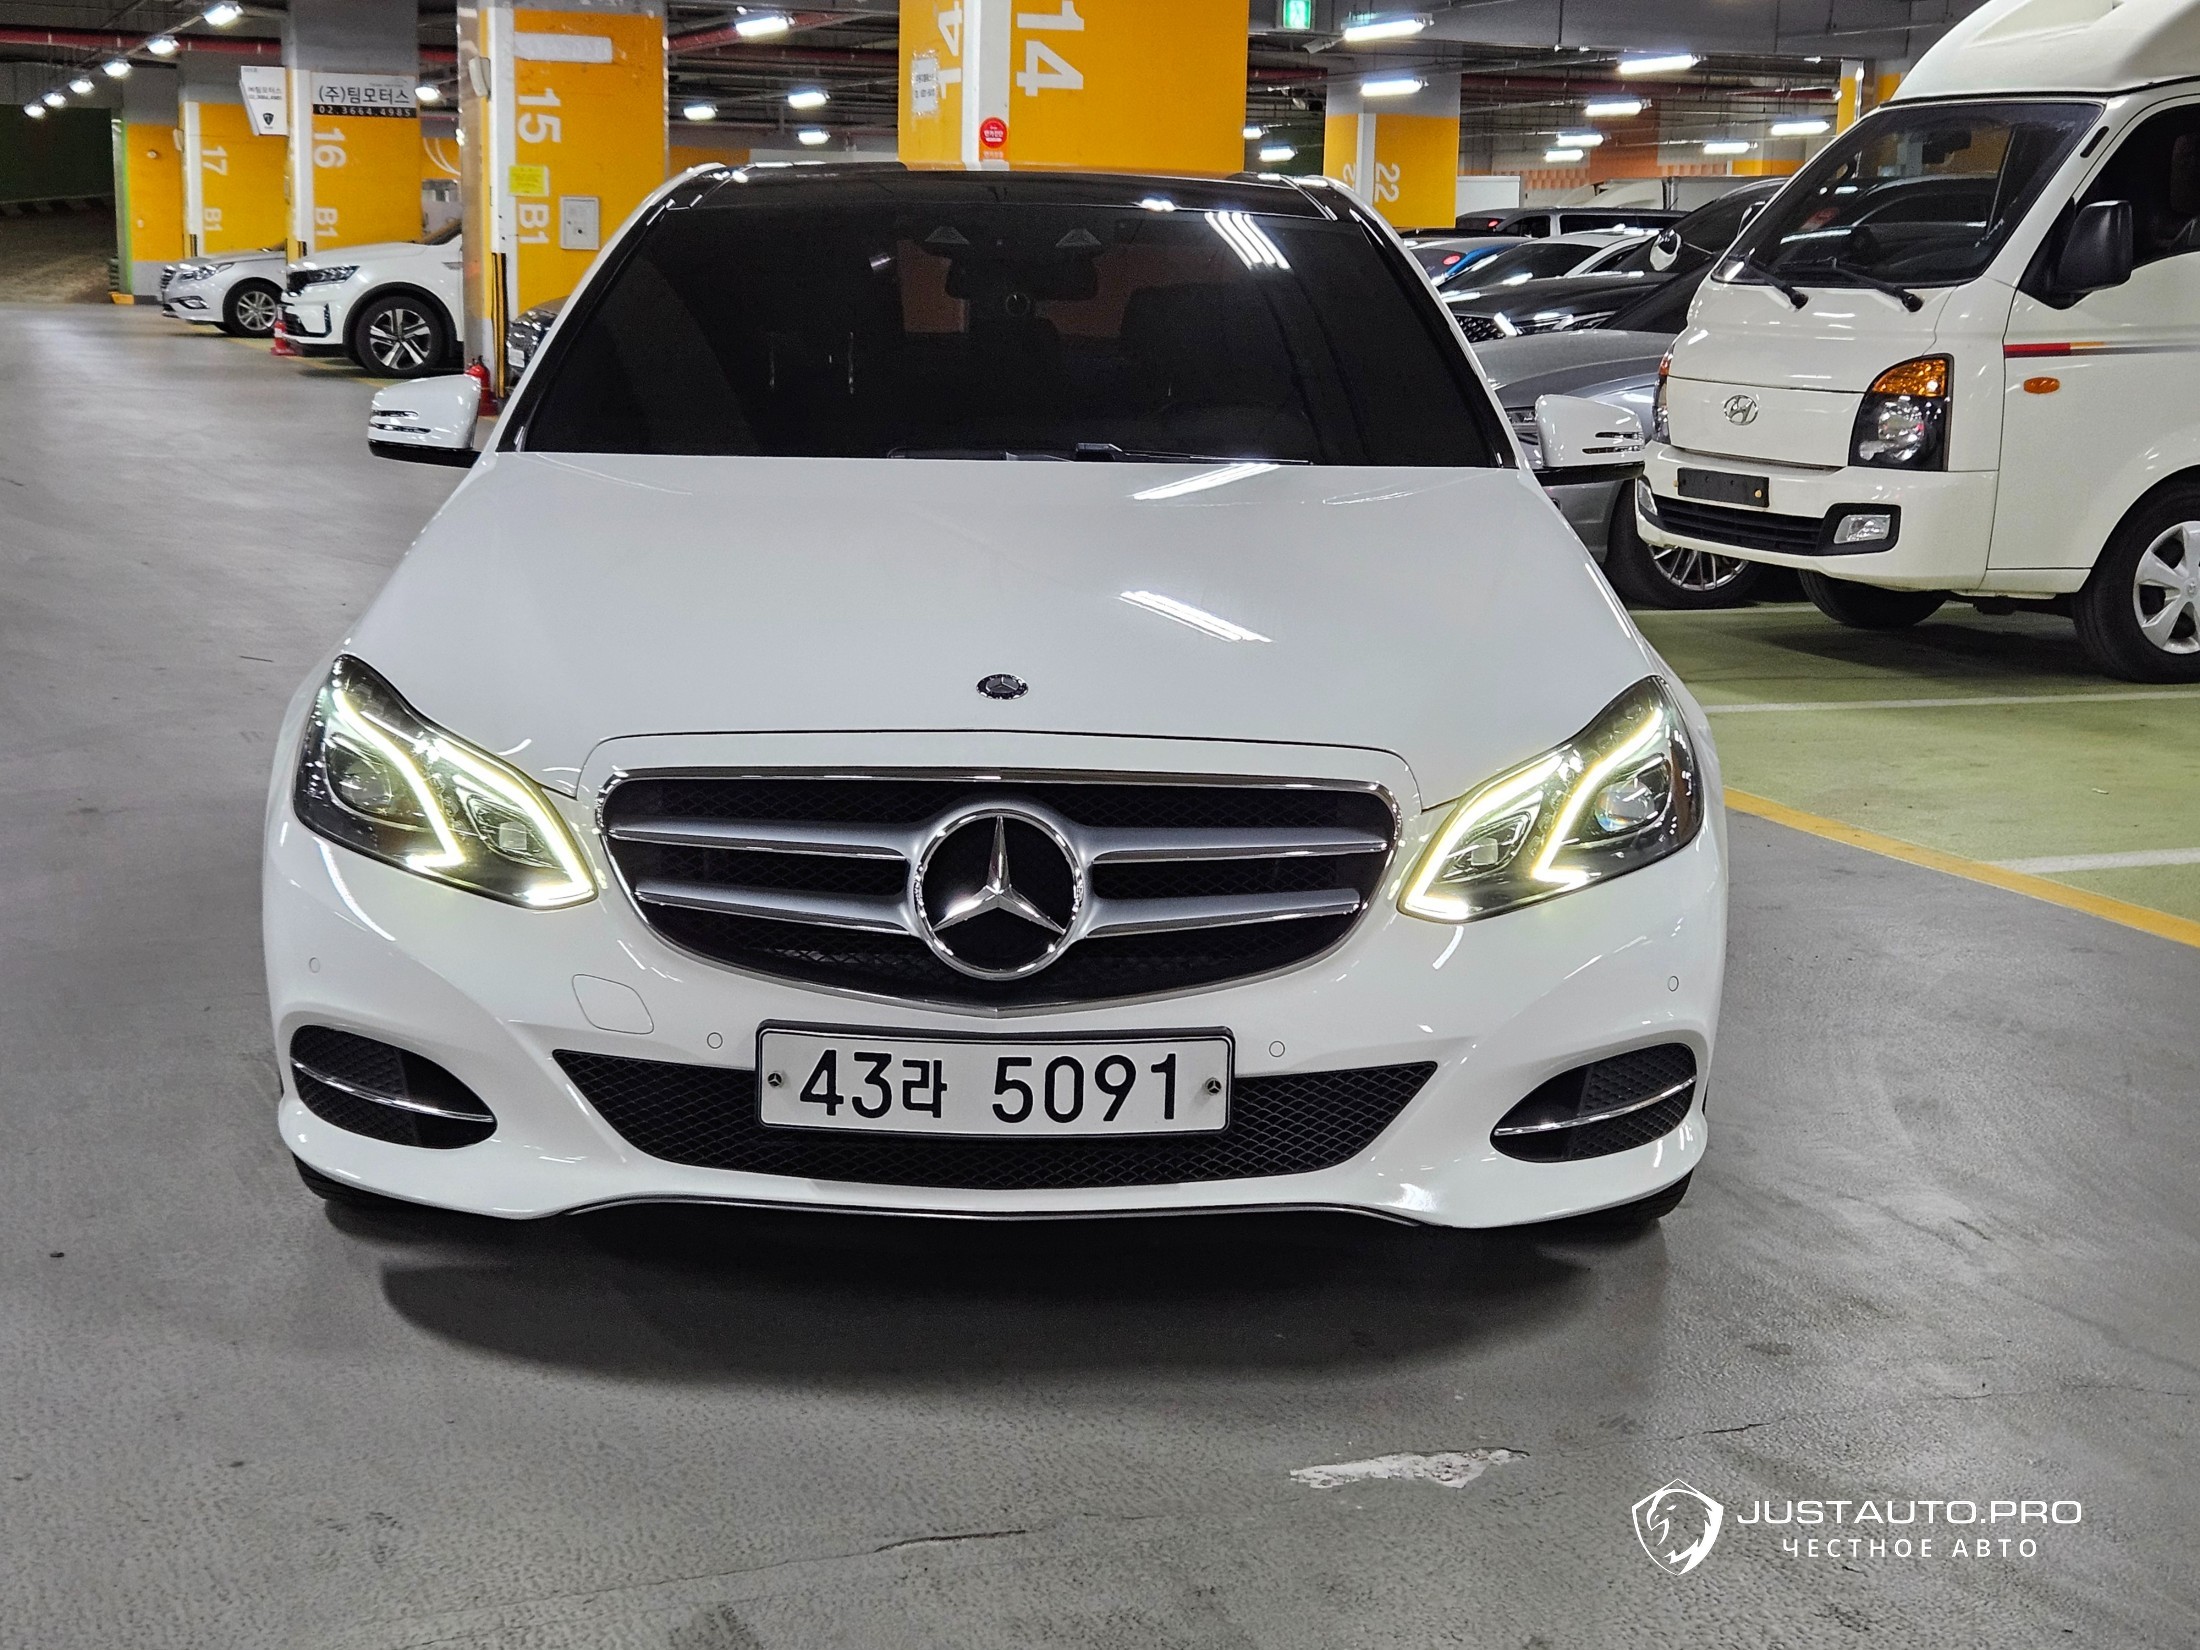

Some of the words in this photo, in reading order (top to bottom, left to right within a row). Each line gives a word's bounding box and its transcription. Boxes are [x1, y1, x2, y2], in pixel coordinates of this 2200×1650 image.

[1016, 0, 1085, 97] 14
[318, 106, 411, 117] 02.3664.4985
[319, 84, 410, 104] (주)팀모터스
[517, 87, 562, 144] 15
[202, 145, 228, 176] 17
[313, 127, 347, 168] 16
[1374, 162, 1400, 203] 22
[204, 207, 223, 232] B1
[315, 207, 338, 237] B1
[518, 203, 550, 245] B1
[799, 1049, 948, 1119] 43라
[991, 1053, 1177, 1124] 5091
